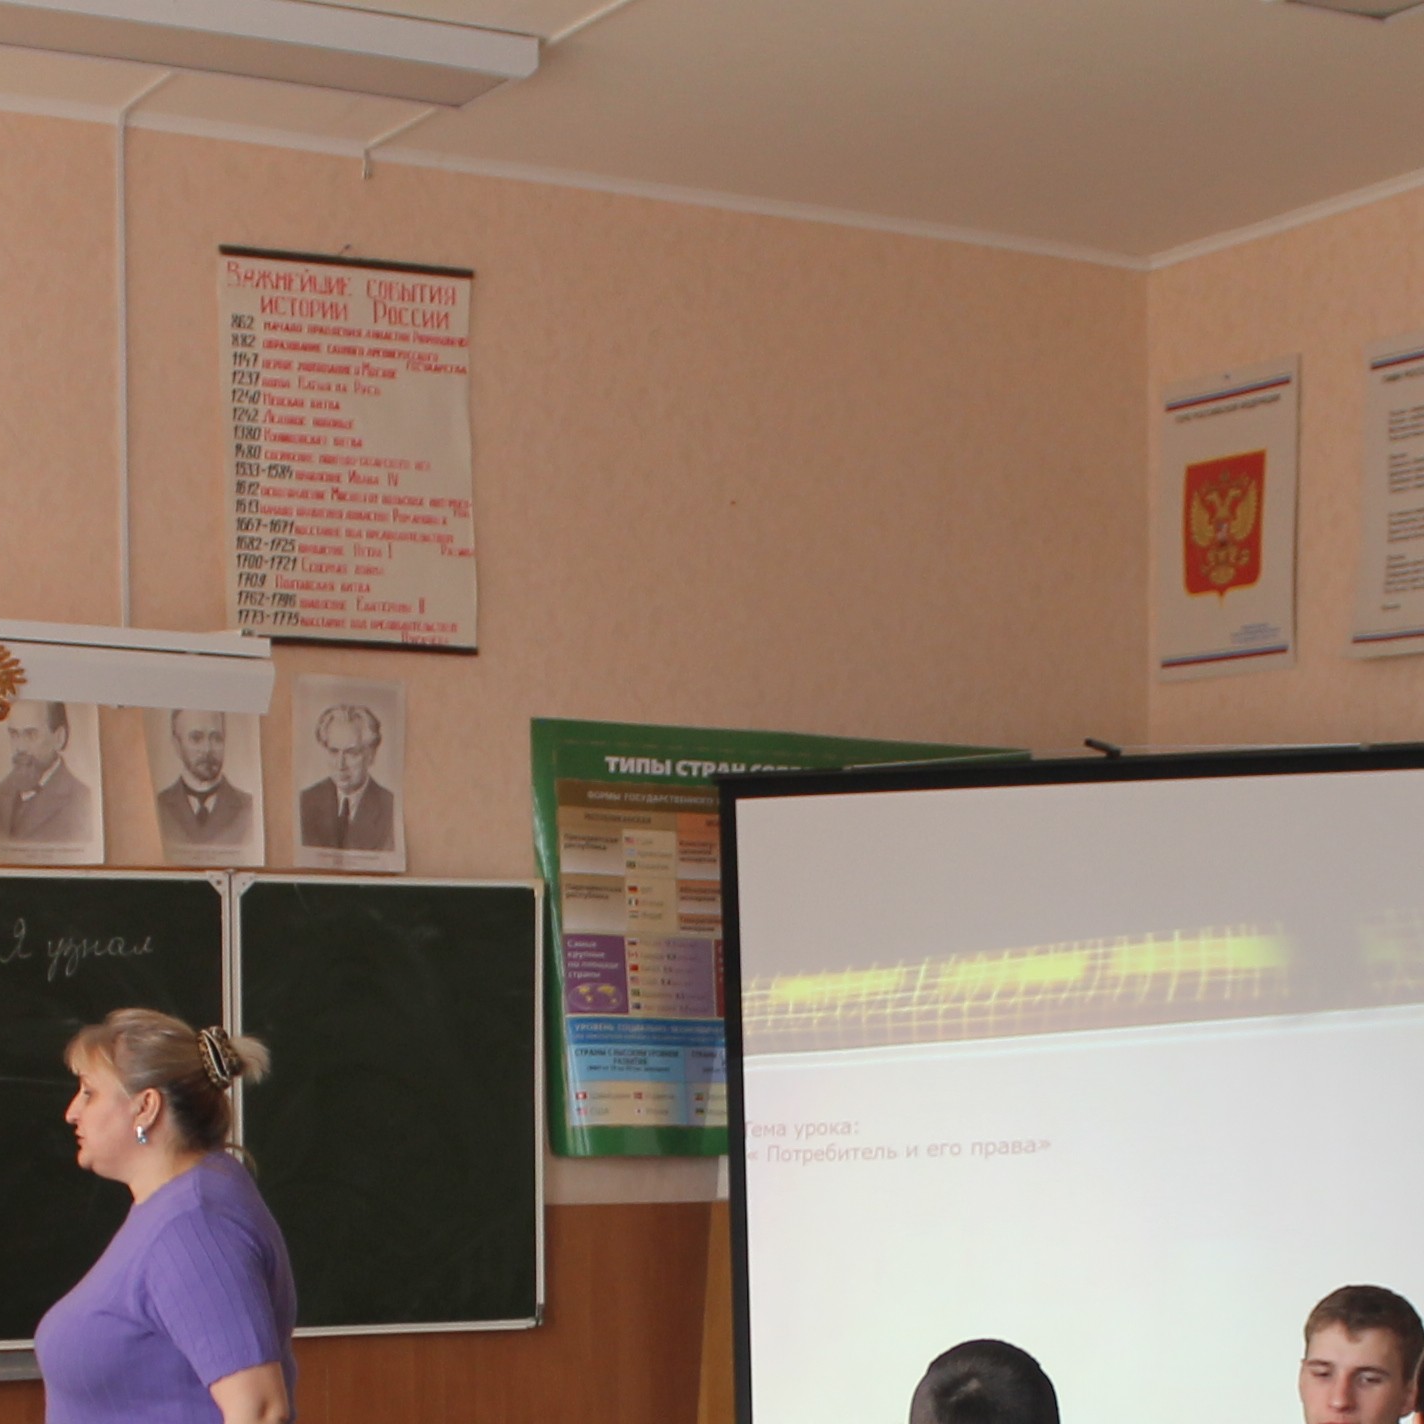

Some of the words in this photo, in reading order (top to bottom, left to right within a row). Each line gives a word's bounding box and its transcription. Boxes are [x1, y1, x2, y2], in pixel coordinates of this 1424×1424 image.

[227, 261, 351, 297] ВАЖНЕЙШИЕ
[366, 279, 456, 306] СОБЫТИЯ
[260, 295, 348, 321] ИСТОРИИ
[373, 299, 450, 330] РОССИИ
[237, 552, 297, 572] 1700-1721
[237, 571, 266, 589] 1709
[604, 755, 672, 776] ТИПЫ
[0, 918, 32, 965] Я
[47, 936, 153, 981] узнал
[794, 1119, 858, 1140] урока:
[767, 1142, 897, 1167] Потребитель
[907, 1145, 918, 1159] и
[927, 1139, 963, 1158] его
[971, 1137, 1052, 1157] права»
